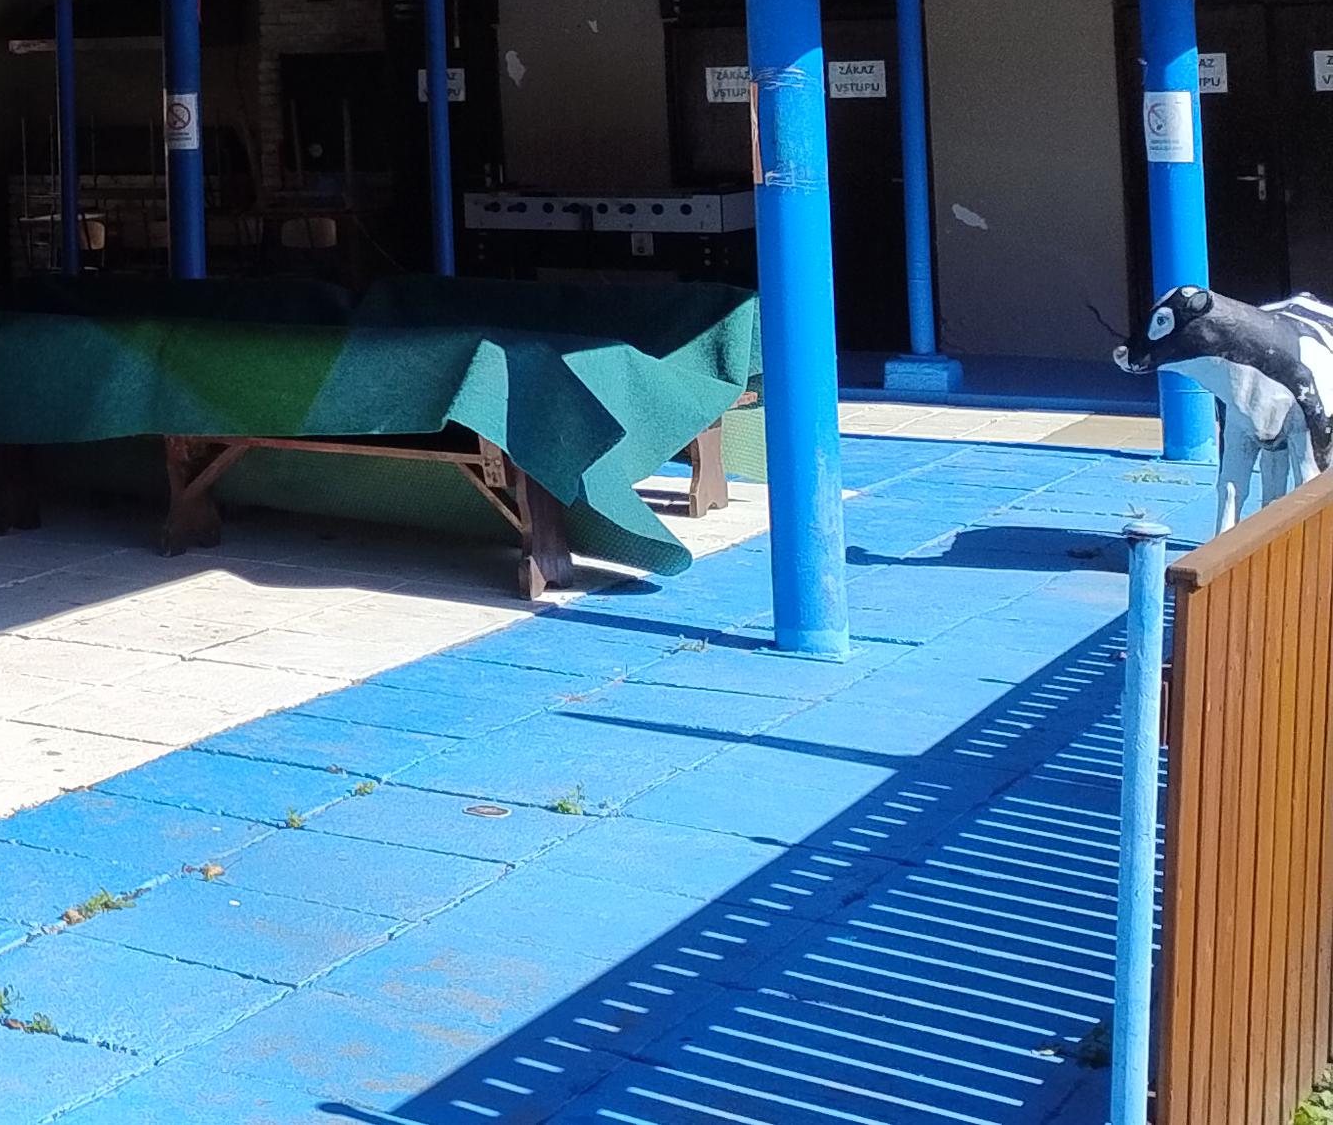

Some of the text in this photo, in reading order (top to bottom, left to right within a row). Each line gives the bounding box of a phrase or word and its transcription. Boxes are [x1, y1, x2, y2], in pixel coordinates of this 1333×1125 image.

[838, 64, 875, 75] ZÁKAZ
[713, 87, 751, 98] VSTUP
[835, 82, 880, 93] VSTUPU
